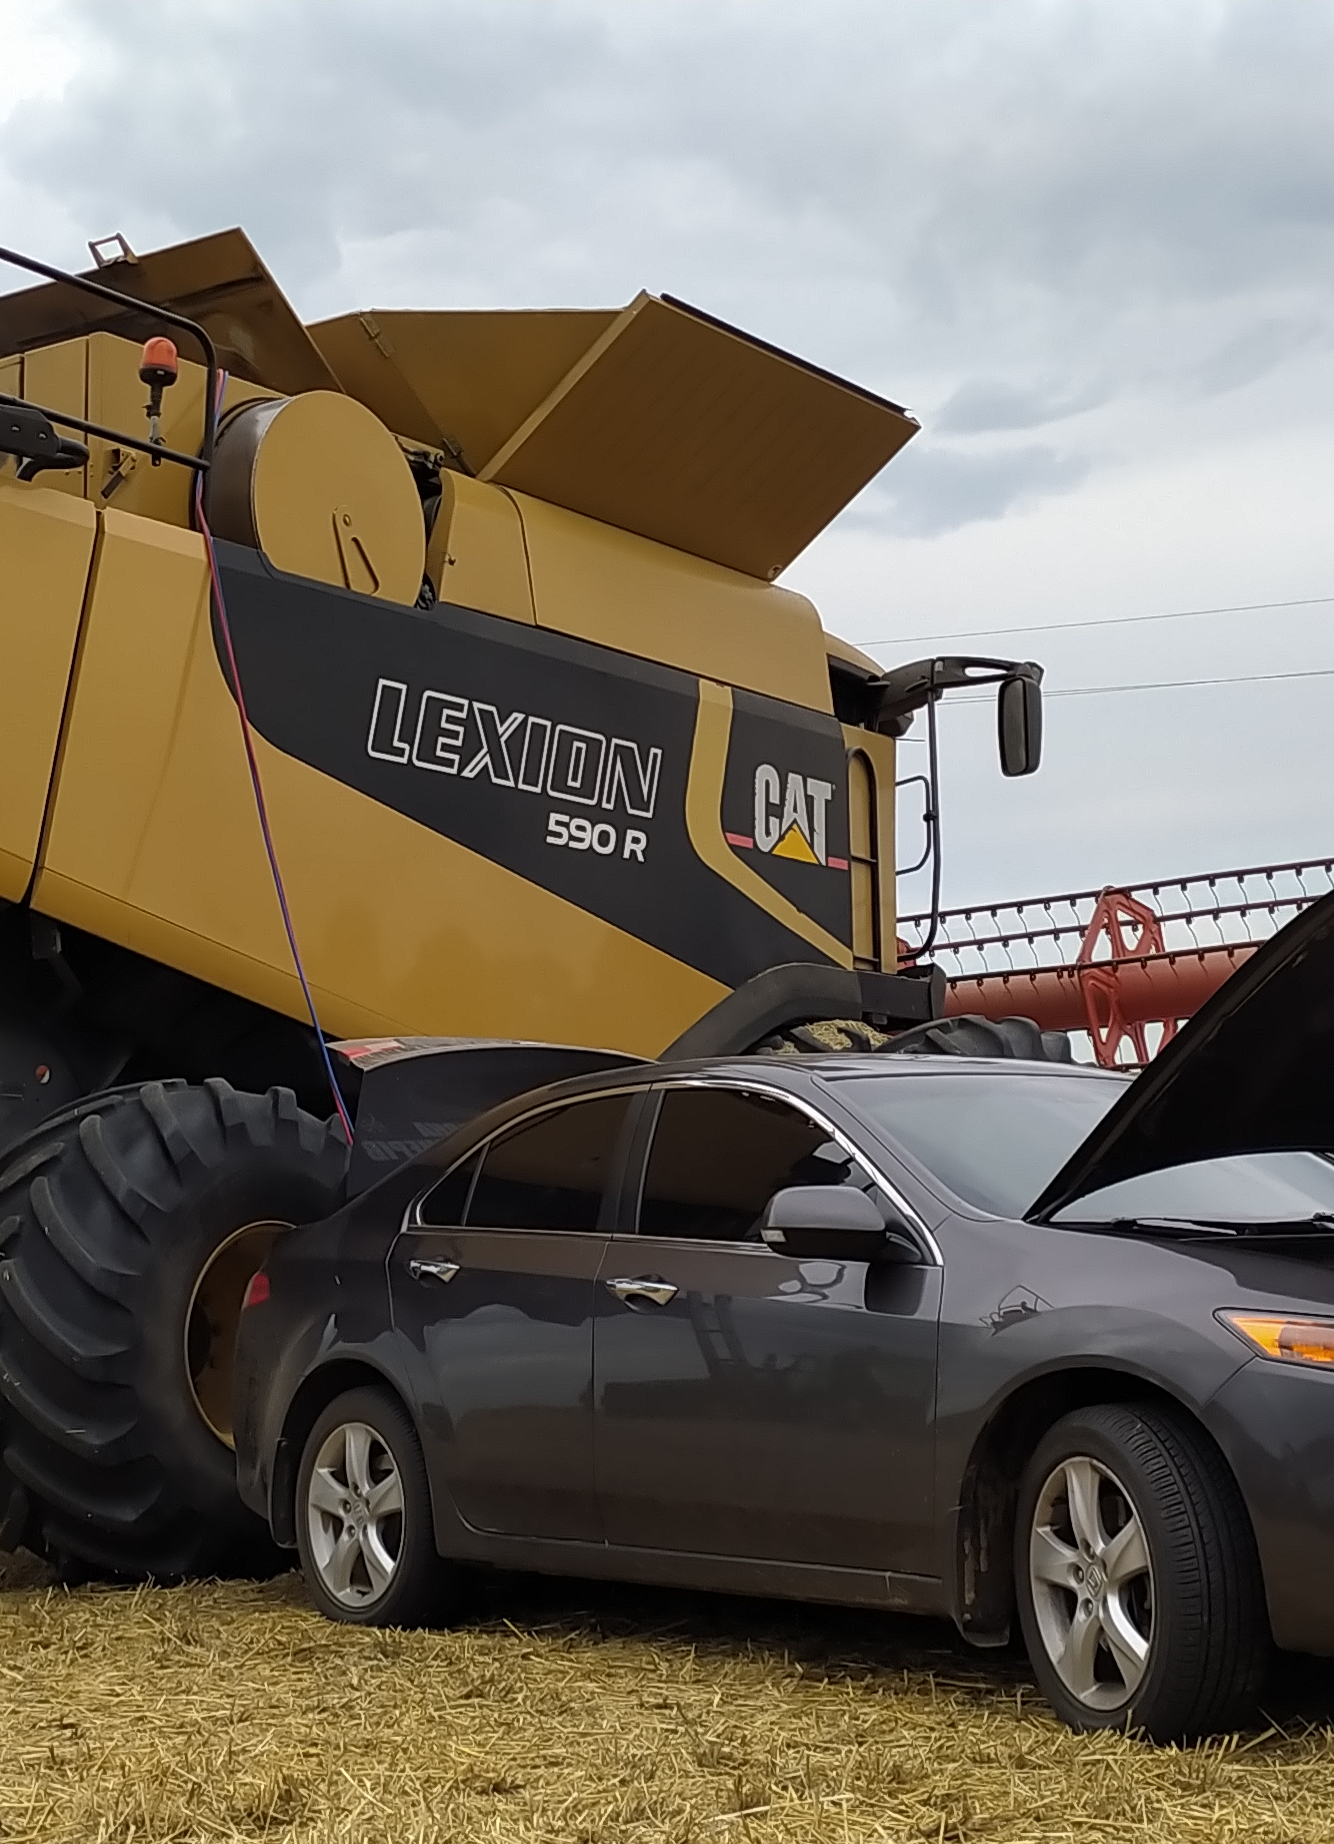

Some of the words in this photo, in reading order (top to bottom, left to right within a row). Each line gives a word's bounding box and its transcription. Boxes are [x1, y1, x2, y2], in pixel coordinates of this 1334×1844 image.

[367, 677, 663, 819] LEXION
[545, 812, 617, 855] 590
[622, 829, 648, 863] R
[754, 763, 833, 867] CAT
